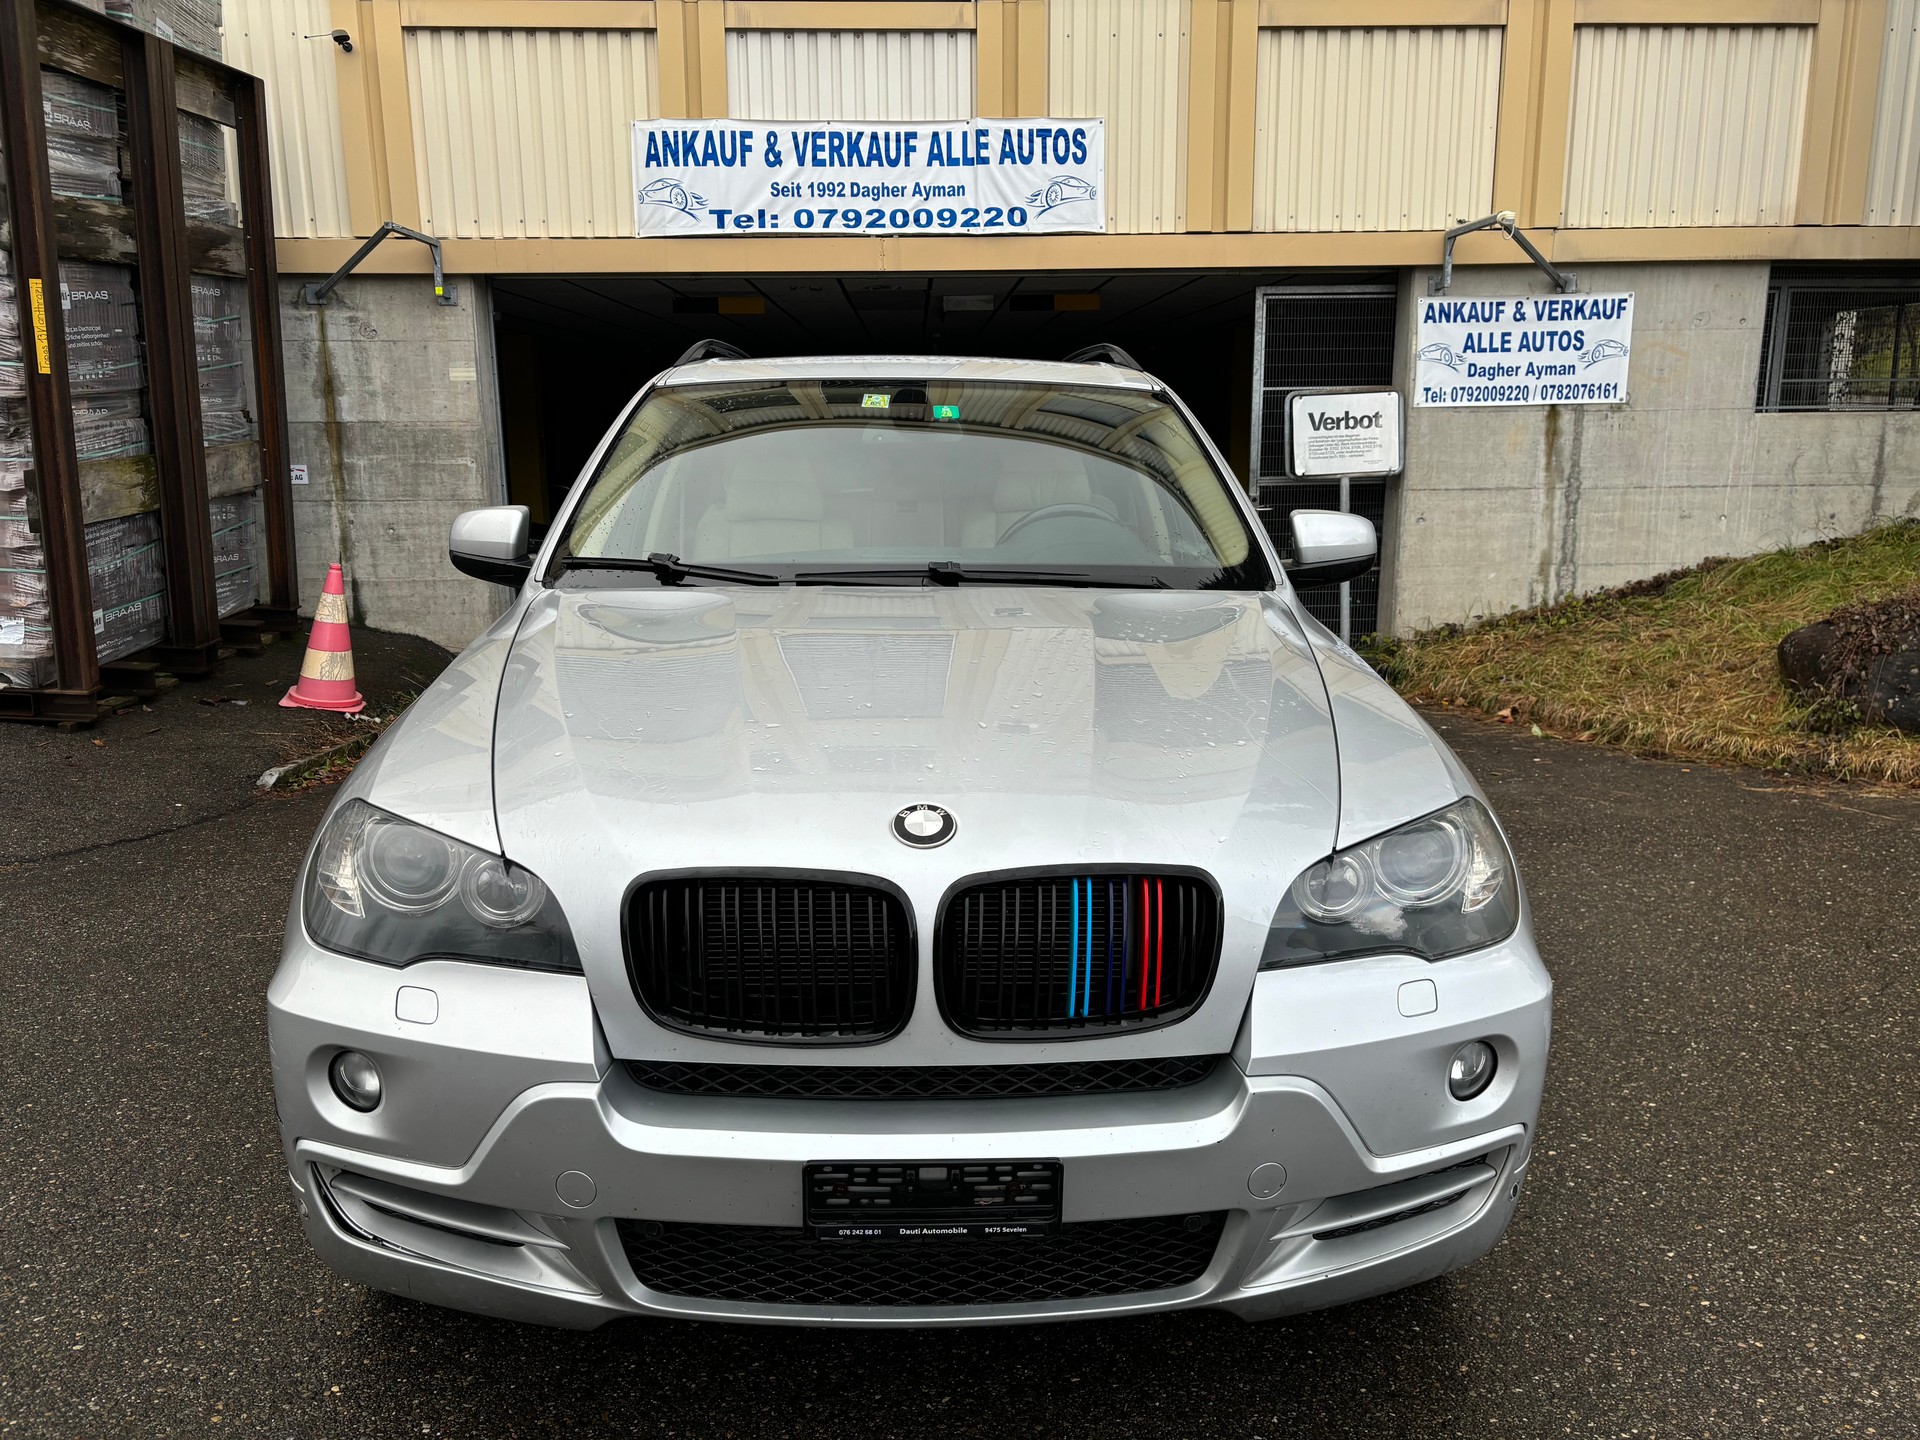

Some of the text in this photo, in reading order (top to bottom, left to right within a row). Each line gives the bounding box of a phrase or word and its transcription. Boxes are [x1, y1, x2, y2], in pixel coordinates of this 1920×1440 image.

[644, 128, 1088, 168] ANKAUF & VERKAUF ALLE AUTOS
[770, 181, 966, 203] Seit 1992 Dagher Ayman
[709, 207, 1028, 229] Tel: 0792009220
[71, 291, 109, 300] BRAAS
[191, 285, 221, 296] BRAAS
[1423, 298, 1628, 324] ANKAUF & VERKAUF
[1462, 330, 1585, 353] ALLE AUTOS
[1468, 362, 1576, 381] Dagher Ayman
[1424, 383, 1618, 403] Tel: 0792009220 / 0782076161
[1308, 411, 1383, 431] Verbot
[105, 602, 142, 623] BRAAS
[898, 804, 947, 818] BMW
[900, 1227, 968, 1235] Dauti Automobile
[1002, 1225, 1027, 1233] Sevelen
